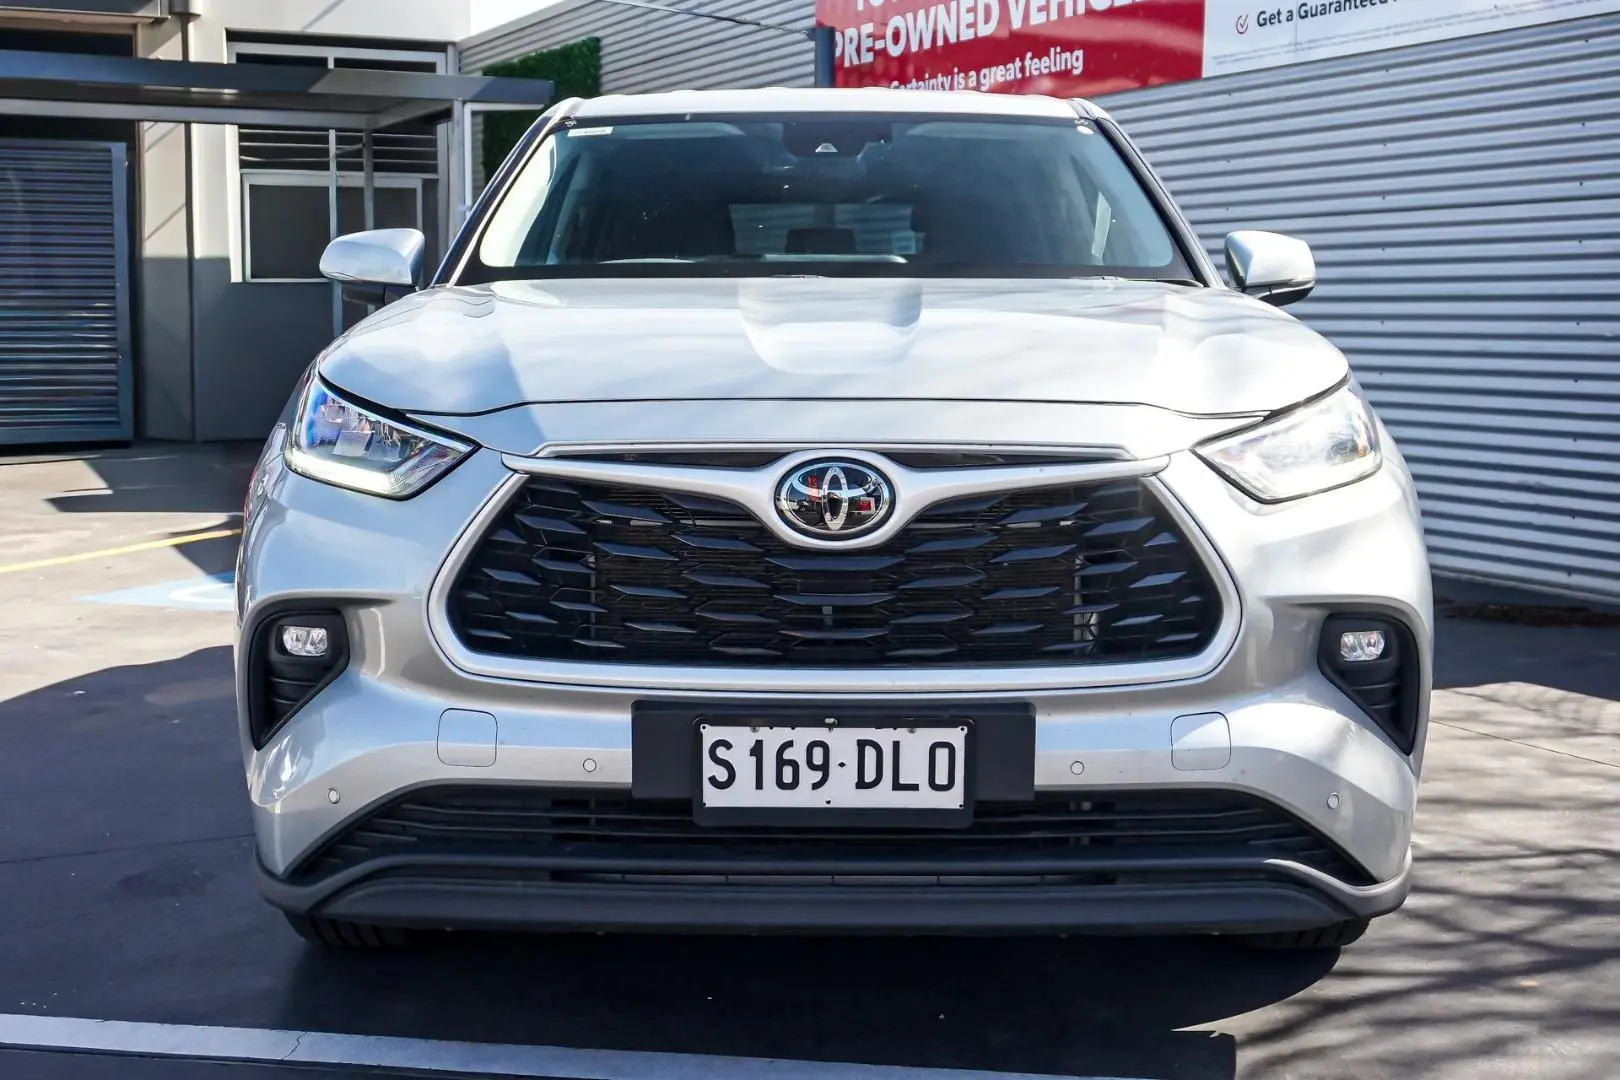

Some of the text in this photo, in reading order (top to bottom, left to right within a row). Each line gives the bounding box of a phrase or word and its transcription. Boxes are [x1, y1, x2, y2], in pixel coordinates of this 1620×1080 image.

[1257, 0, 1388, 27] Get a Guarantee
[890, 46, 1084, 91] tainty is a great feeling
